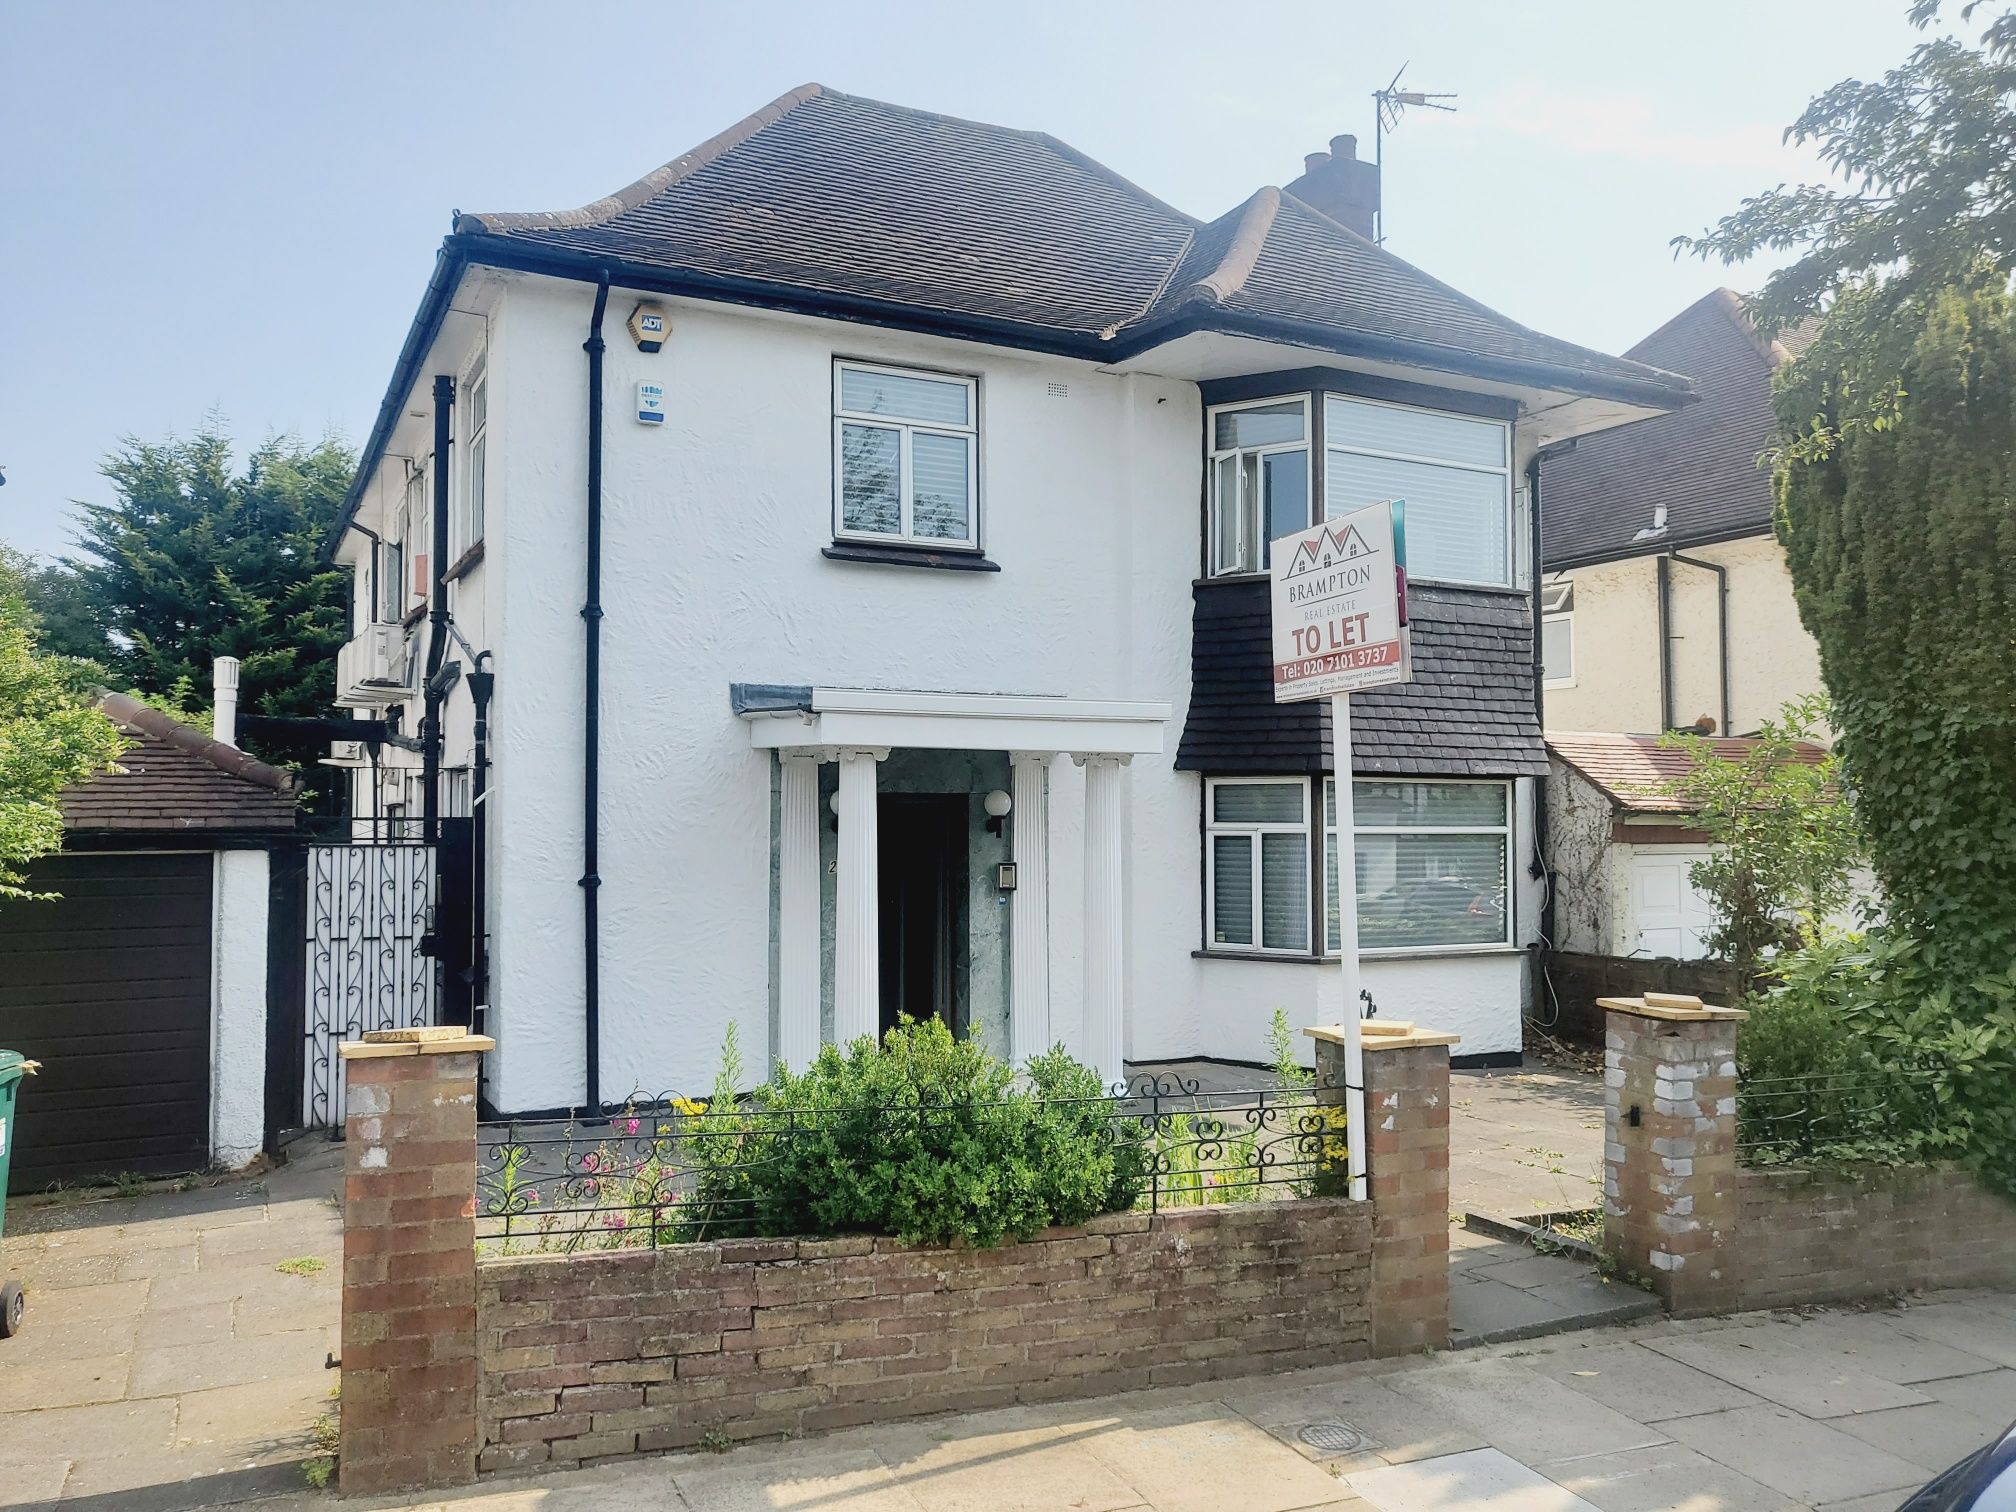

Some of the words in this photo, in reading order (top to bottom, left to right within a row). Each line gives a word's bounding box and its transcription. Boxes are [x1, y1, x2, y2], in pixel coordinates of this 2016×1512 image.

[642, 318, 661, 329] ADT
[1289, 565, 1371, 603] BRAMPTON
[1304, 605, 1324, 621] REAL
[1327, 600, 1356, 616] ESTATE
[1292, 625, 1321, 656] TO
[1329, 612, 1370, 649] LET
[1282, 664, 1300, 679] Tel:
[1303, 659, 1324, 676] 020
[1327, 652, 1355, 672] 7101
[1358, 646, 1387, 665] 3737
[1364, 670, 1372, 678] and
